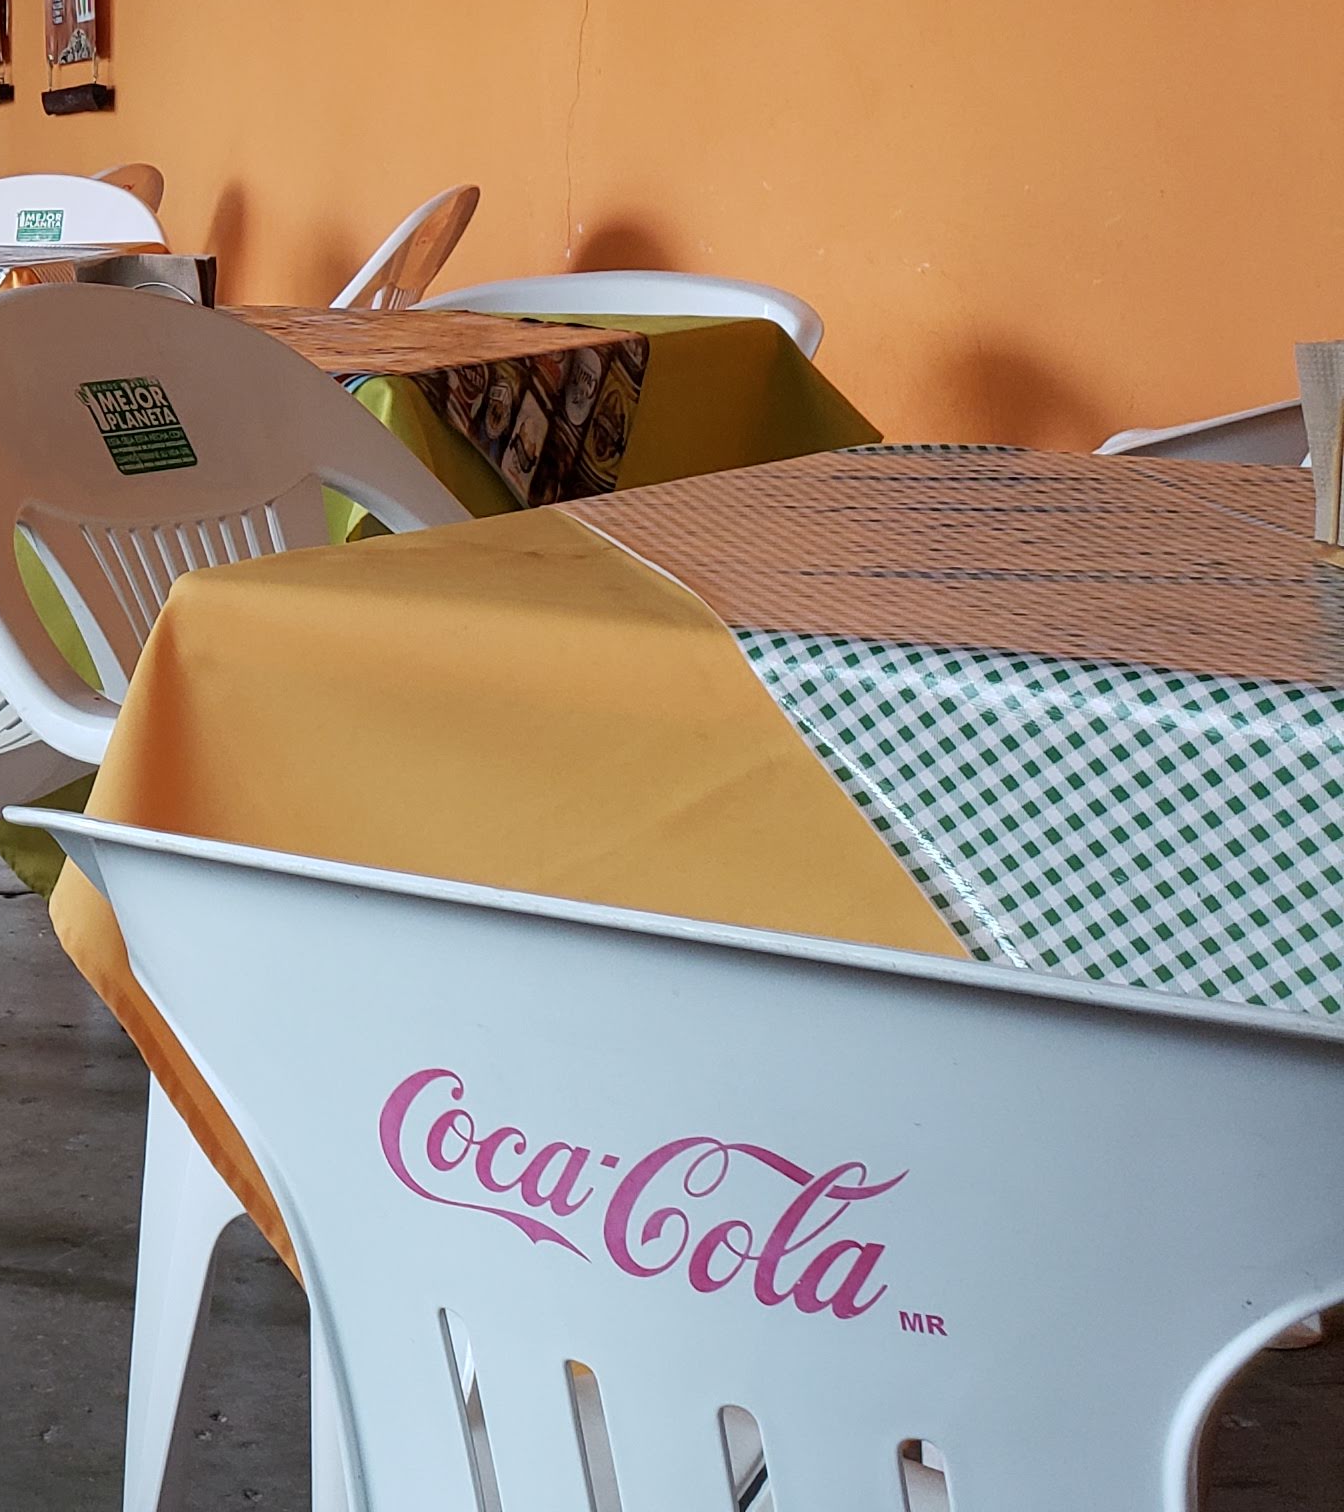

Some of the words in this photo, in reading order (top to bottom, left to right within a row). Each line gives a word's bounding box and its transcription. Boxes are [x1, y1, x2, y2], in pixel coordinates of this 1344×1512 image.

[97, 382, 169, 413] MEJOR
[105, 407, 178, 431] PLANETA
[379, 1068, 910, 1320] Coca-Cola
[897, 1310, 948, 1337] MR
